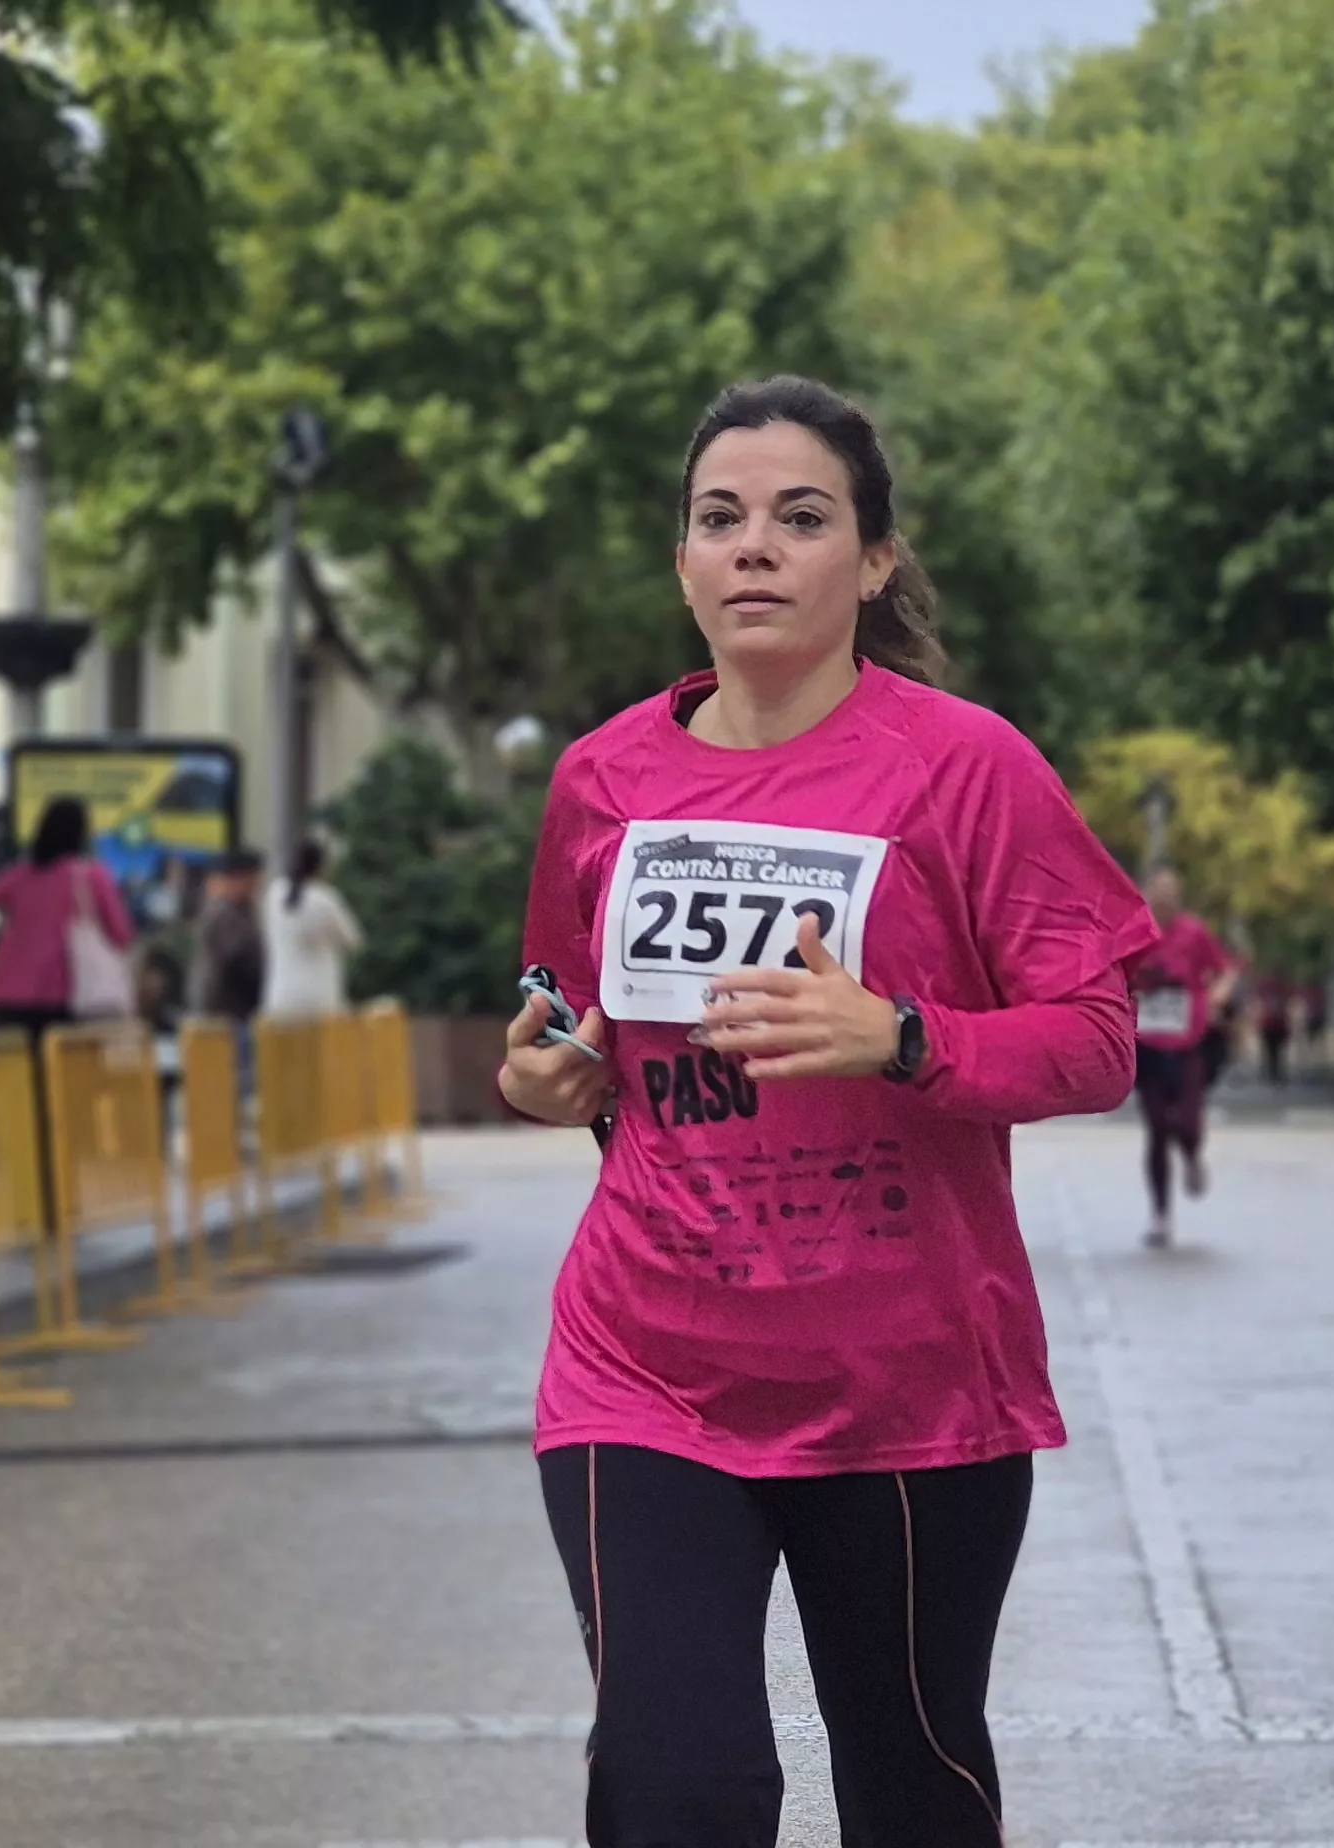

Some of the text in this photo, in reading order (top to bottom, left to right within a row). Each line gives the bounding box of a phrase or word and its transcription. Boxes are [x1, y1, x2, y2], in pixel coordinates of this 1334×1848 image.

[715, 844, 776, 862] HUESCA
[646, 858, 845, 888] CONTRA EL CÁNCER
[630, 890, 836, 968] 2572
